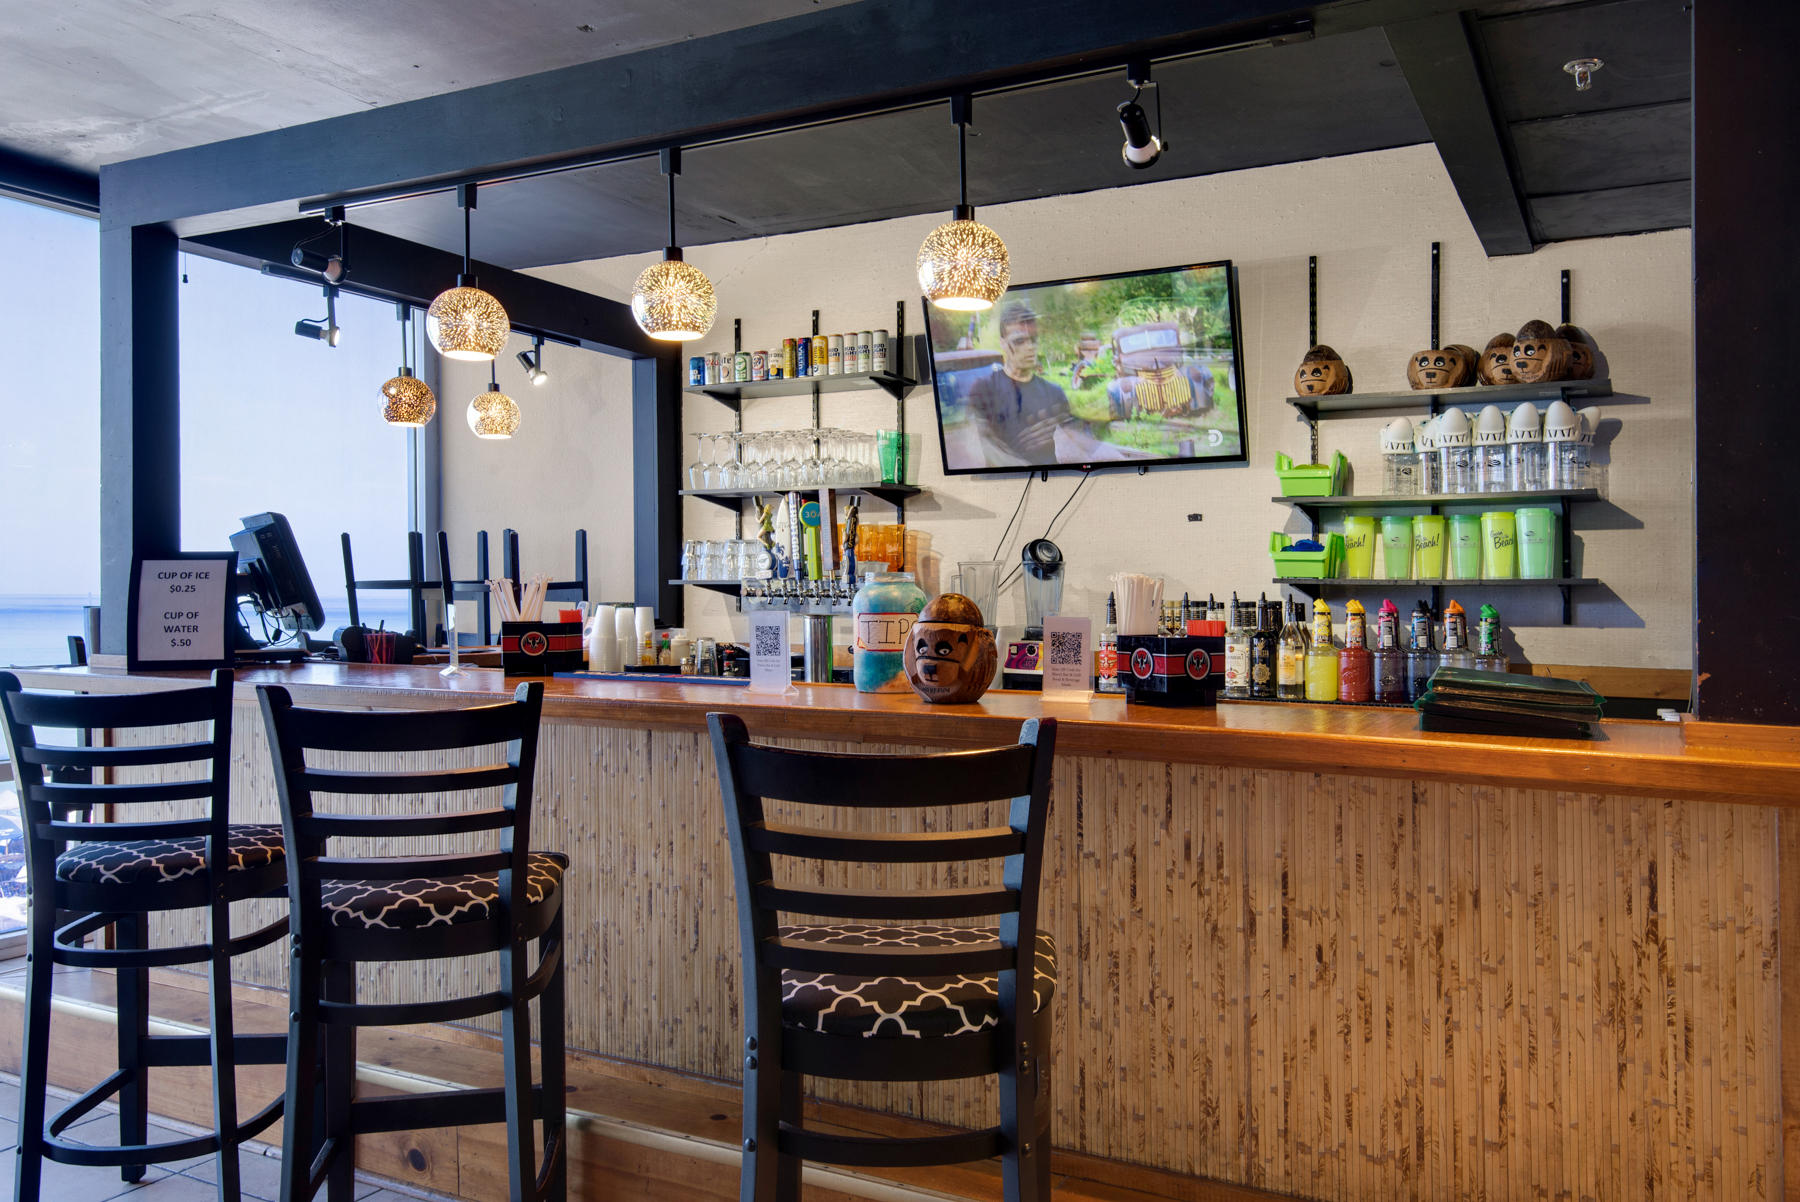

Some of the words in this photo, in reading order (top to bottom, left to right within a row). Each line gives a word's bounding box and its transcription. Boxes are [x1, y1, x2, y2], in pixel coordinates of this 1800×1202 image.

[789, 504, 799, 536] LIGHT
[791, 537, 800, 560] BUD
[157, 571, 178, 580] CUP
[180, 571, 193, 580] OF
[195, 571, 211, 580] ICE
[169, 584, 196, 594] $0.25
[163, 611, 184, 620] CUP
[186, 611, 200, 620] OF
[163, 625, 199, 633] WATER
[170, 638, 192, 648] $.50
